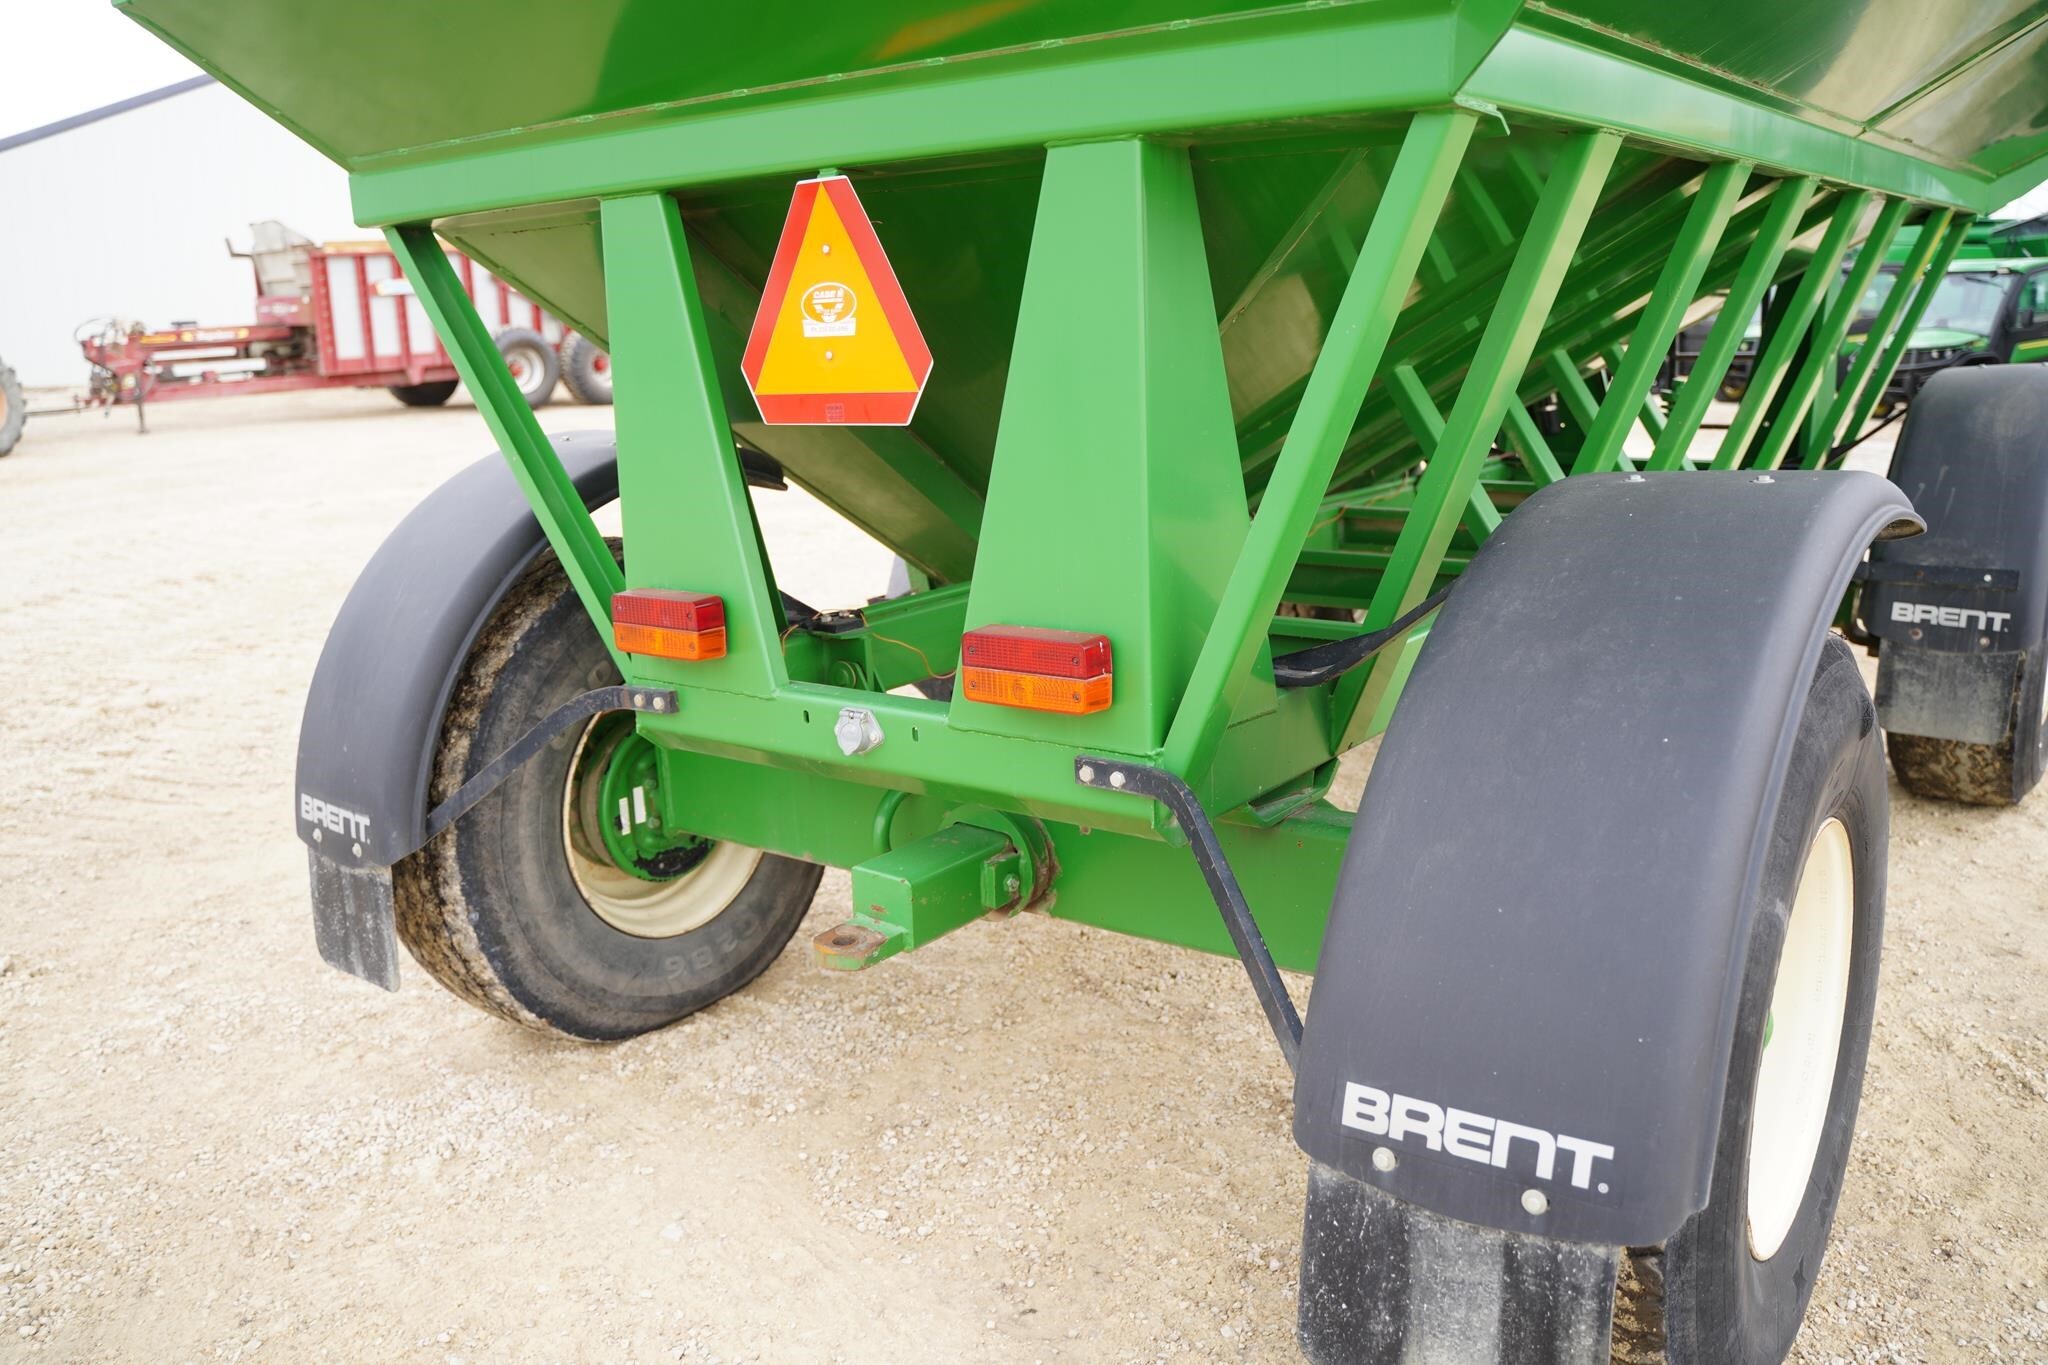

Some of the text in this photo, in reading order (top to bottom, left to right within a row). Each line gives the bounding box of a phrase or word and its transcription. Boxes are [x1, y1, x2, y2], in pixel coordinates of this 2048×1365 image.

[1891, 601, 2011, 632] BRENT
[300, 793, 371, 844] BRENT
[1342, 1081, 1615, 1189] BRENT
